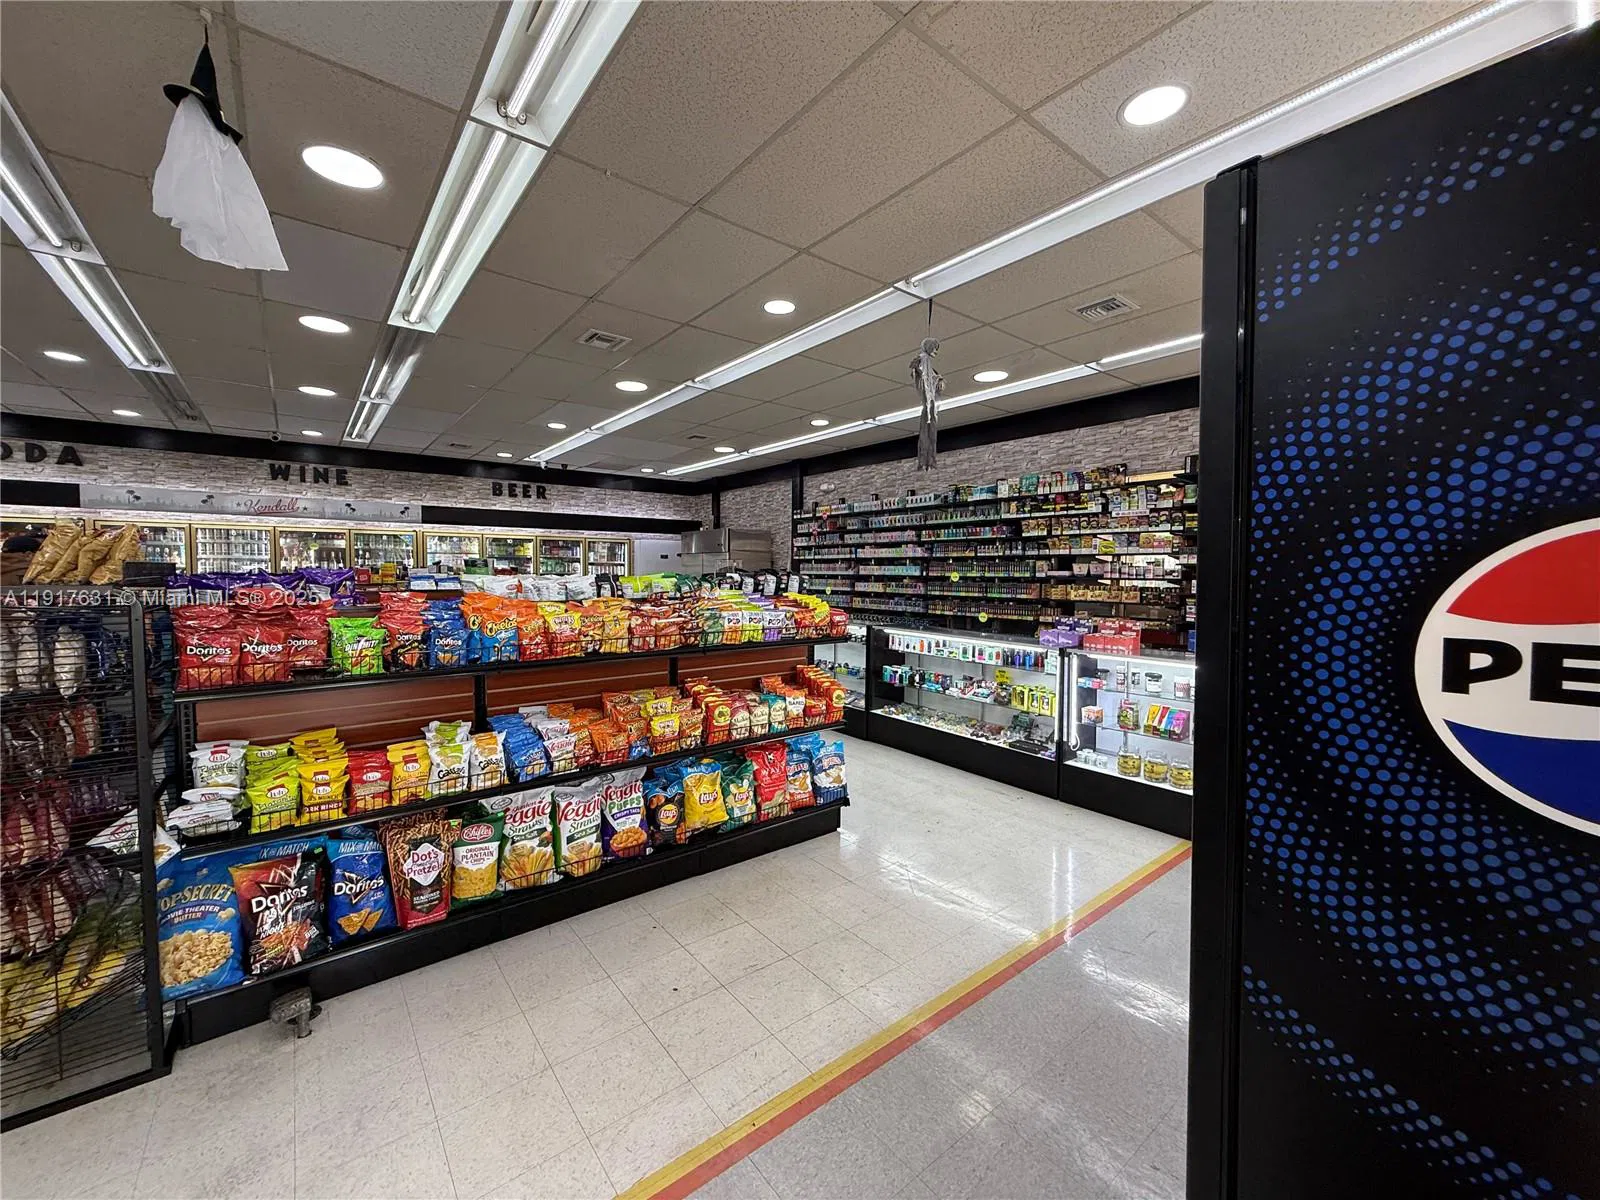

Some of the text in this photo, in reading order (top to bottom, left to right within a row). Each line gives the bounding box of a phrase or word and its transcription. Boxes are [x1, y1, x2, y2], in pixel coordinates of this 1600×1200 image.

[269, 463, 349, 486] WINE
[492, 481, 547, 500] BEER
[244, 497, 299, 515] Kendall
[486, 617, 517, 637] Cheetos
[241, 643, 283, 653] Doritos
[435, 638, 462, 646] Doritos
[187, 646, 232, 655] Doritos
[504, 799, 552, 827] eggie
[338, 842, 356, 853] MIX
[465, 846, 490, 854] ORIGINAL
[411, 850, 439, 863] Dot's
[461, 850, 494, 860] PLANTAIN
[334, 876, 385, 896] Doritos
[251, 885, 308, 914] Doritos
[185, 905, 220, 914] THEATER
[174, 912, 202, 923] BUTTER
